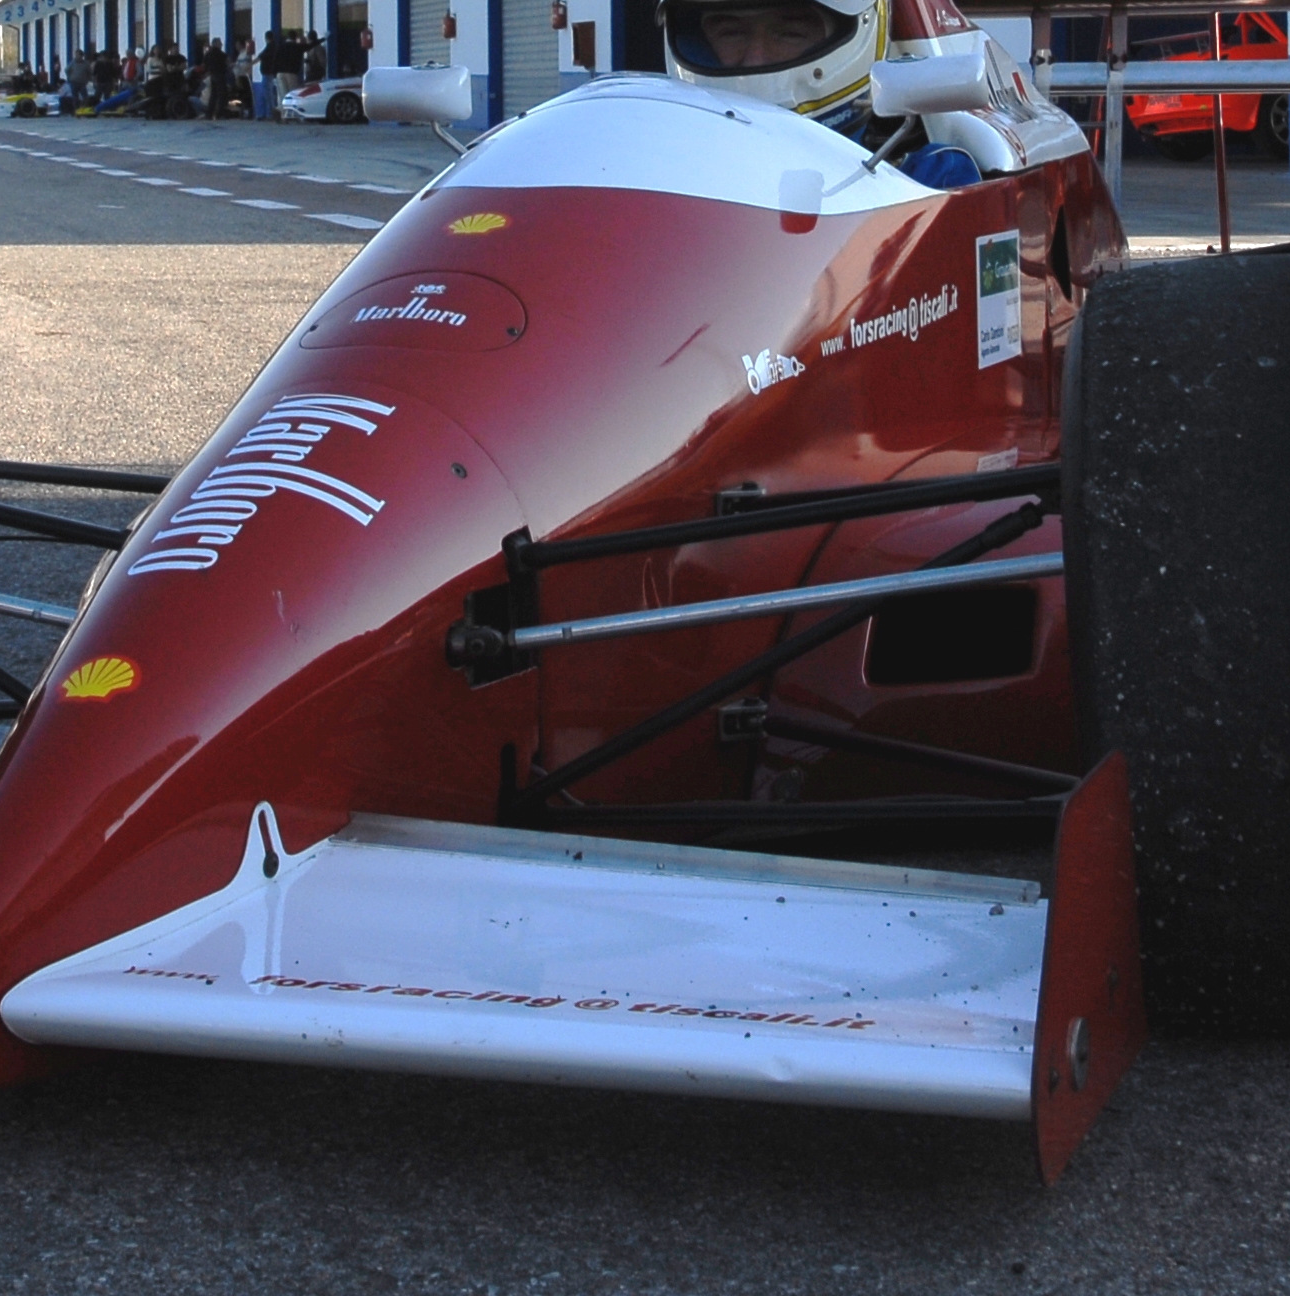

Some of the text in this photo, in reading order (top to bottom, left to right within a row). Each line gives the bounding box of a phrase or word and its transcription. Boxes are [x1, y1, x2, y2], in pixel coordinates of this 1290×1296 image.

[5, 11, 12, 21] 2
[17, 6, 25, 17] 3
[31, 1, 40, 12] 4
[351, 296, 467, 326] Marlboro
[820, 336, 846, 357] www.
[127, 393, 395, 576] Marlboro
[248, 974, 567, 1008] forsracing
